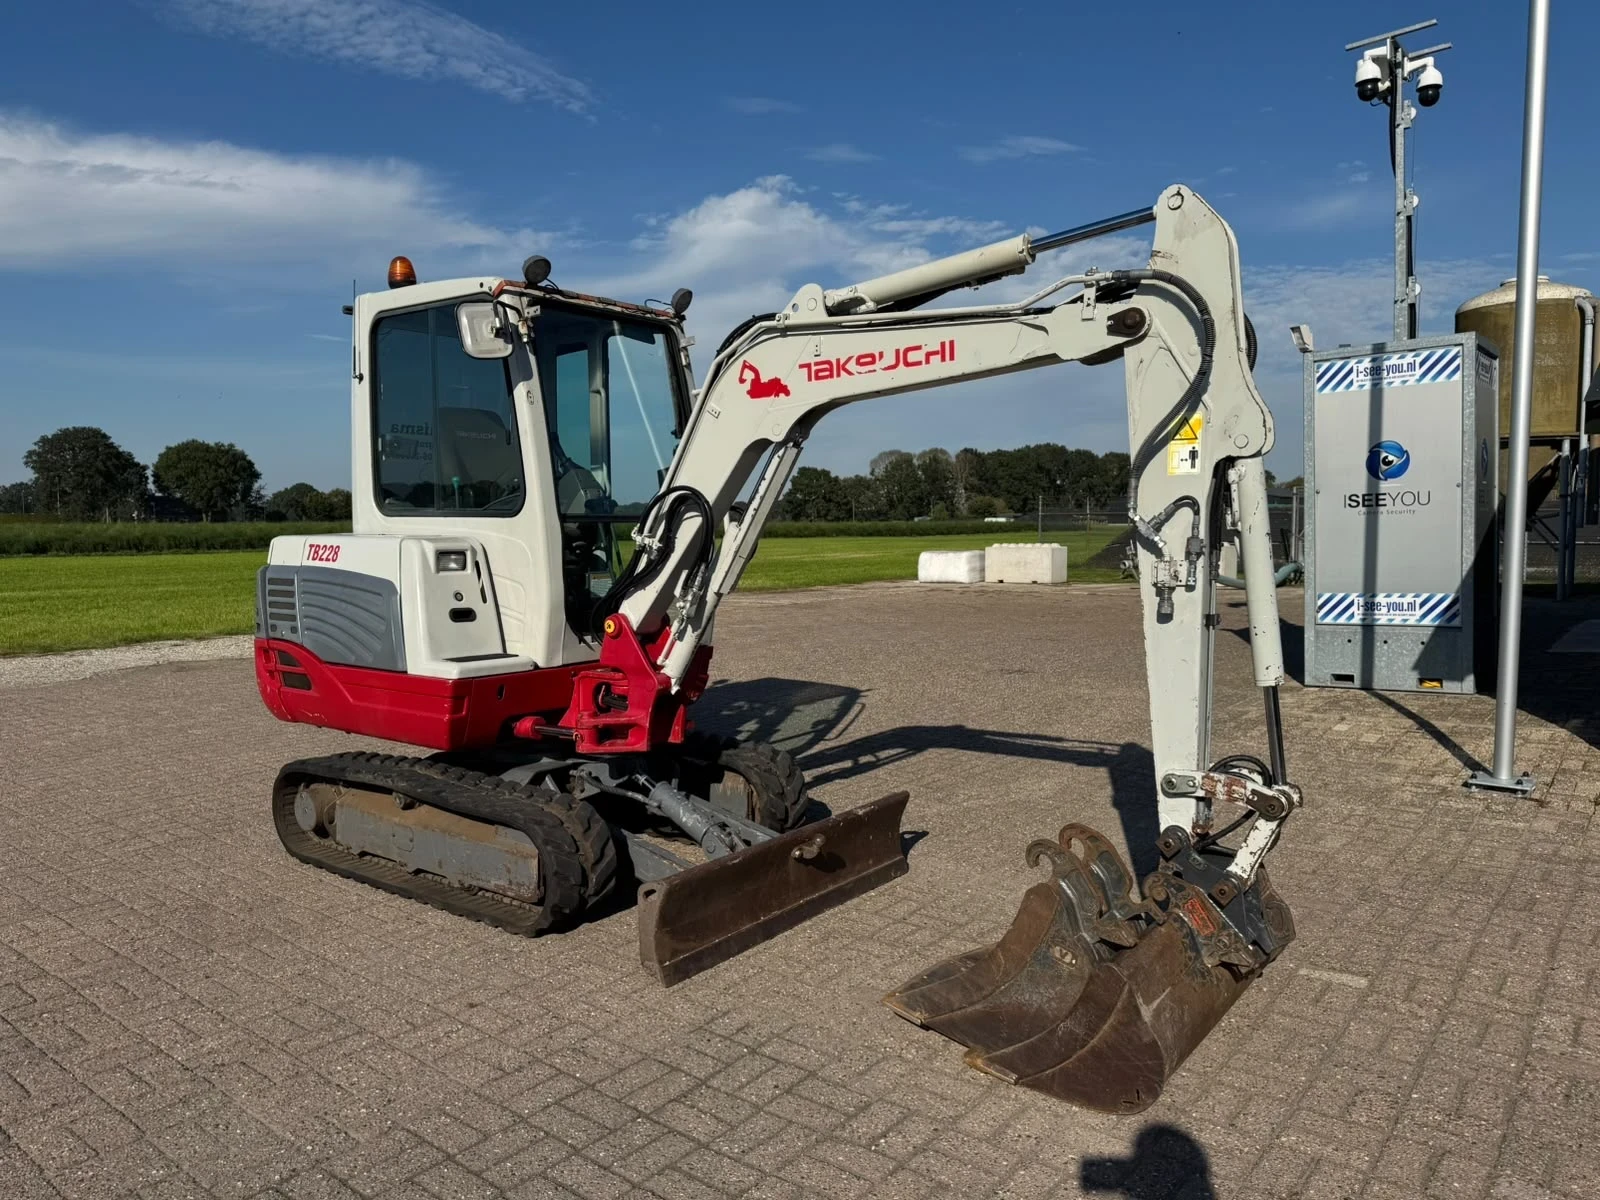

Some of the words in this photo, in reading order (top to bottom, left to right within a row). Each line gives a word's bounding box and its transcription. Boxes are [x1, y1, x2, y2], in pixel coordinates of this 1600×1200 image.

[1356, 359, 1417, 378] i-see-you.nl
[1343, 490, 1431, 508] ISEEYOU
[307, 544, 341, 562] TB228
[1357, 600, 1417, 613] i-see-you.nl
